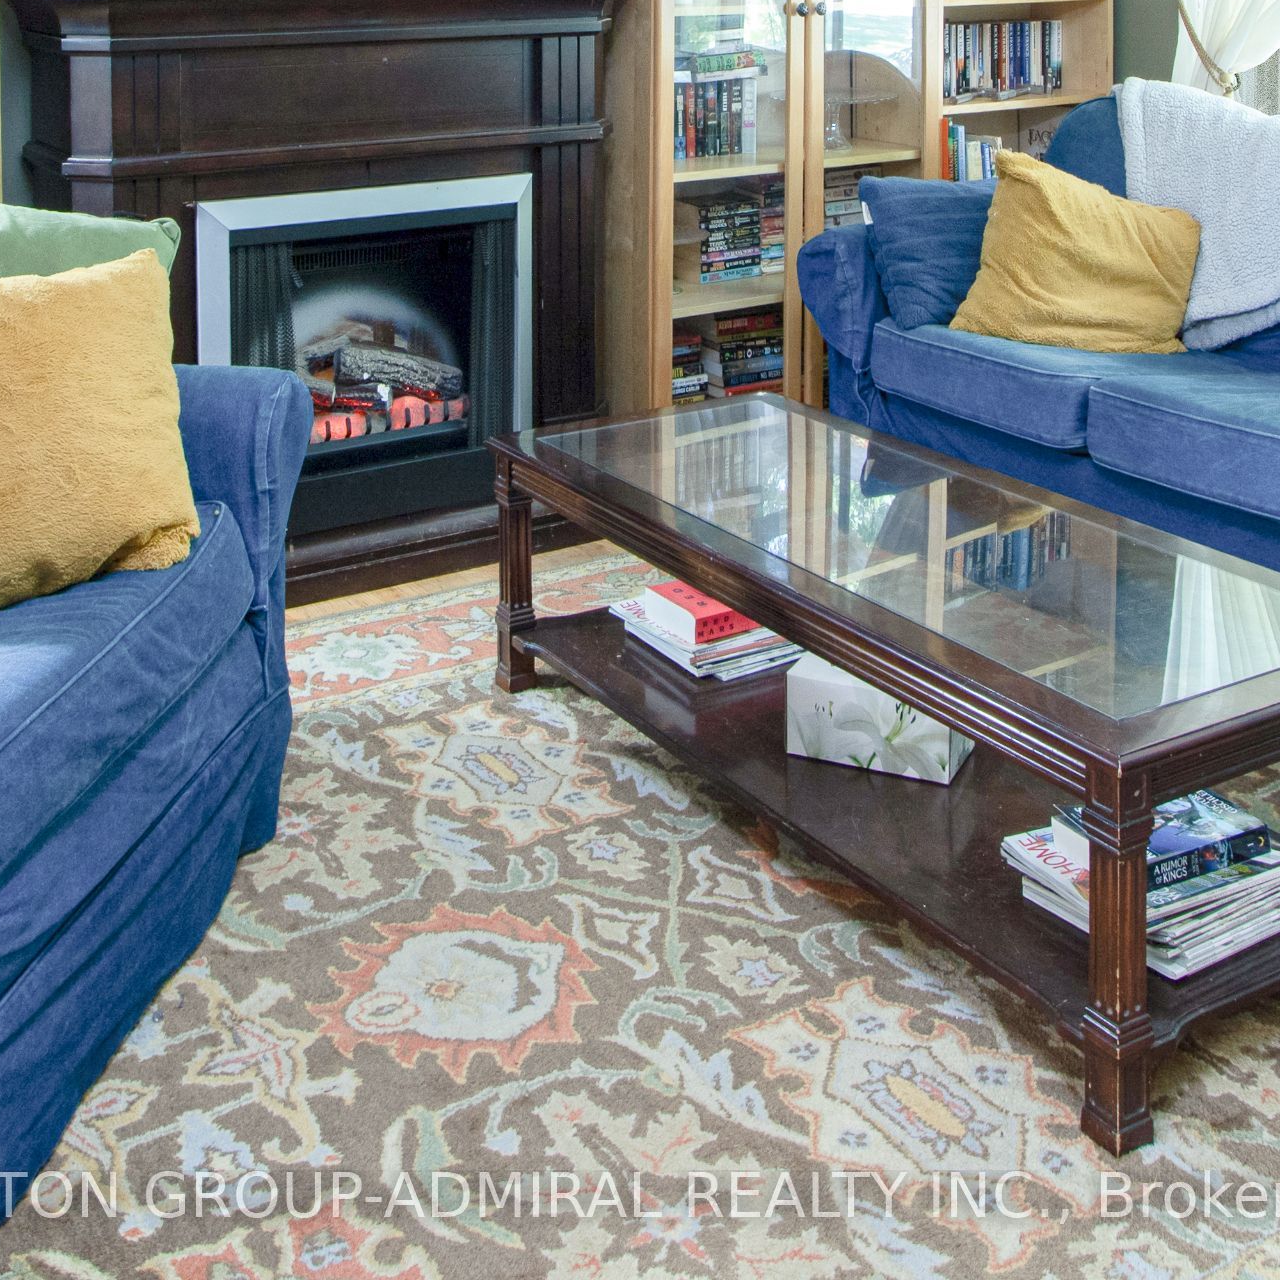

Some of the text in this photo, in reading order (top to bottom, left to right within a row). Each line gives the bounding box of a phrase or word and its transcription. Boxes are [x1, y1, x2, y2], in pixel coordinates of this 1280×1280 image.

[697, 623, 735, 638] MARS
[702, 615, 730, 627] RED
[1016, 835, 1080, 875] HOME
[1152, 855, 1188, 875] A RUMOR
[1154, 866, 1188, 885] OF KINGS
